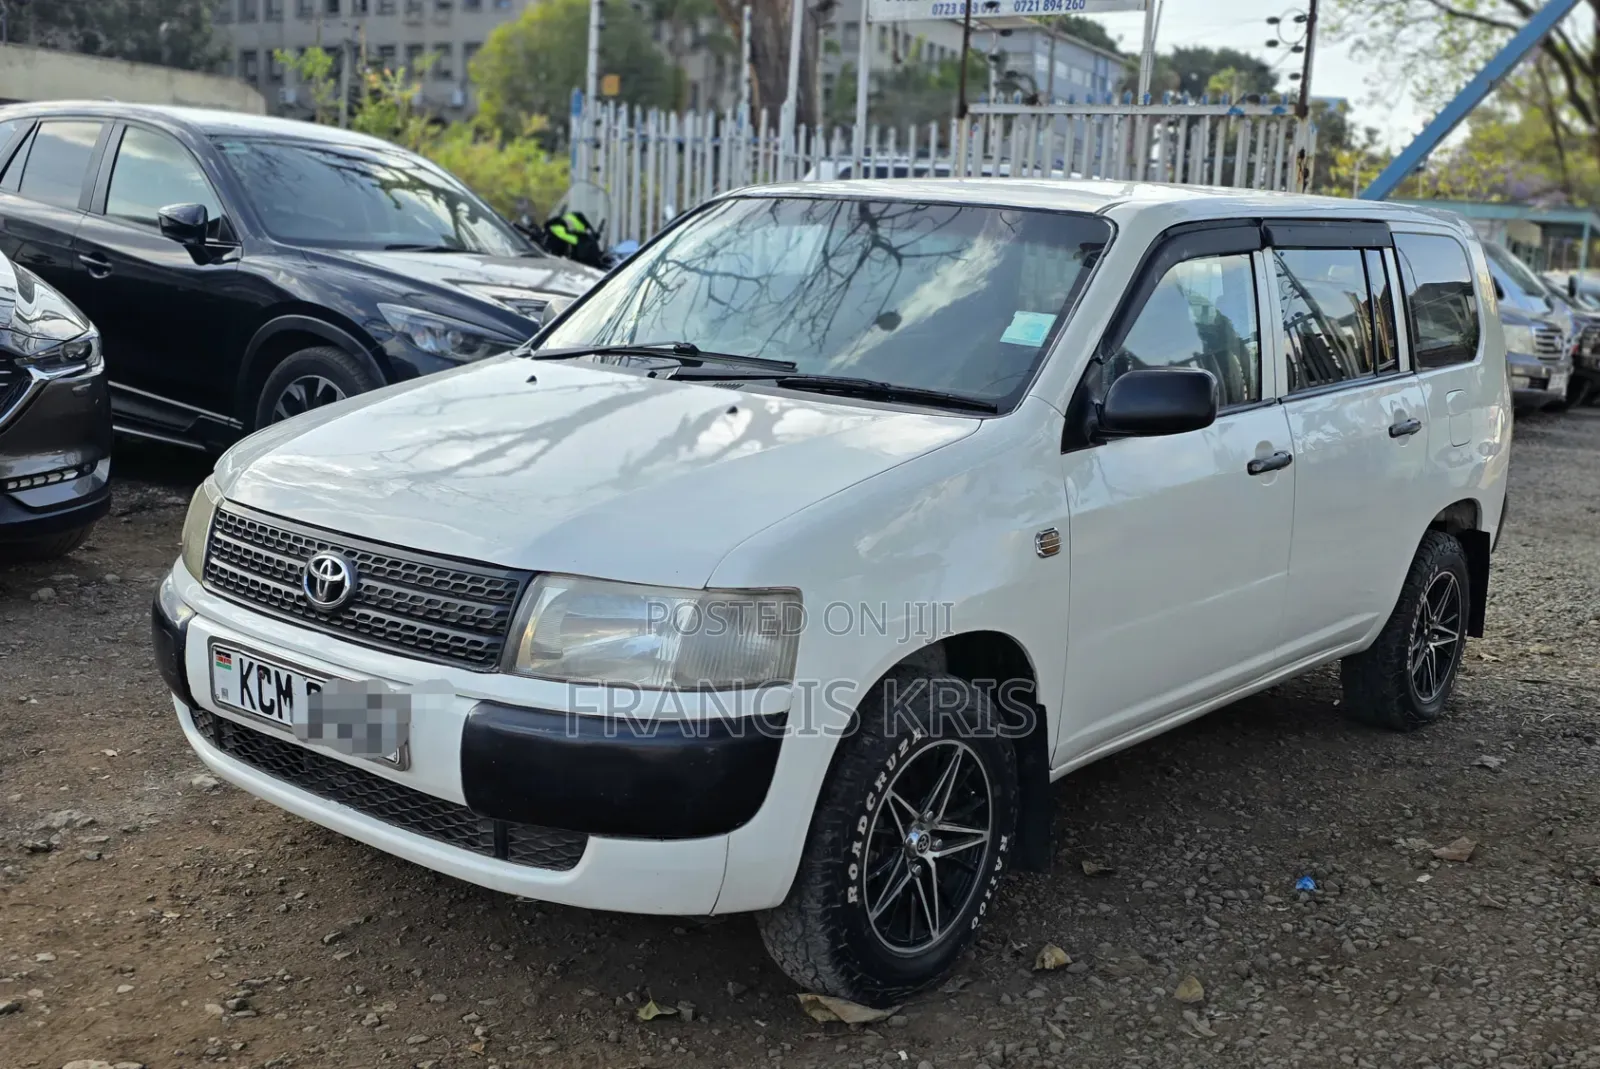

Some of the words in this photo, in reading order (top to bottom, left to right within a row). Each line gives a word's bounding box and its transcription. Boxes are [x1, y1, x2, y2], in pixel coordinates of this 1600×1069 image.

[932, 3, 957, 15] 0723
[959, 2, 978, 15] 83
[1014, 1, 1039, 12] 0721
[1043, 0, 1062, 11] 894
[1065, 0, 1085, 10] 260
[238, 657, 294, 720] KCM
[847, 726, 923, 904] ROADCRUZA
